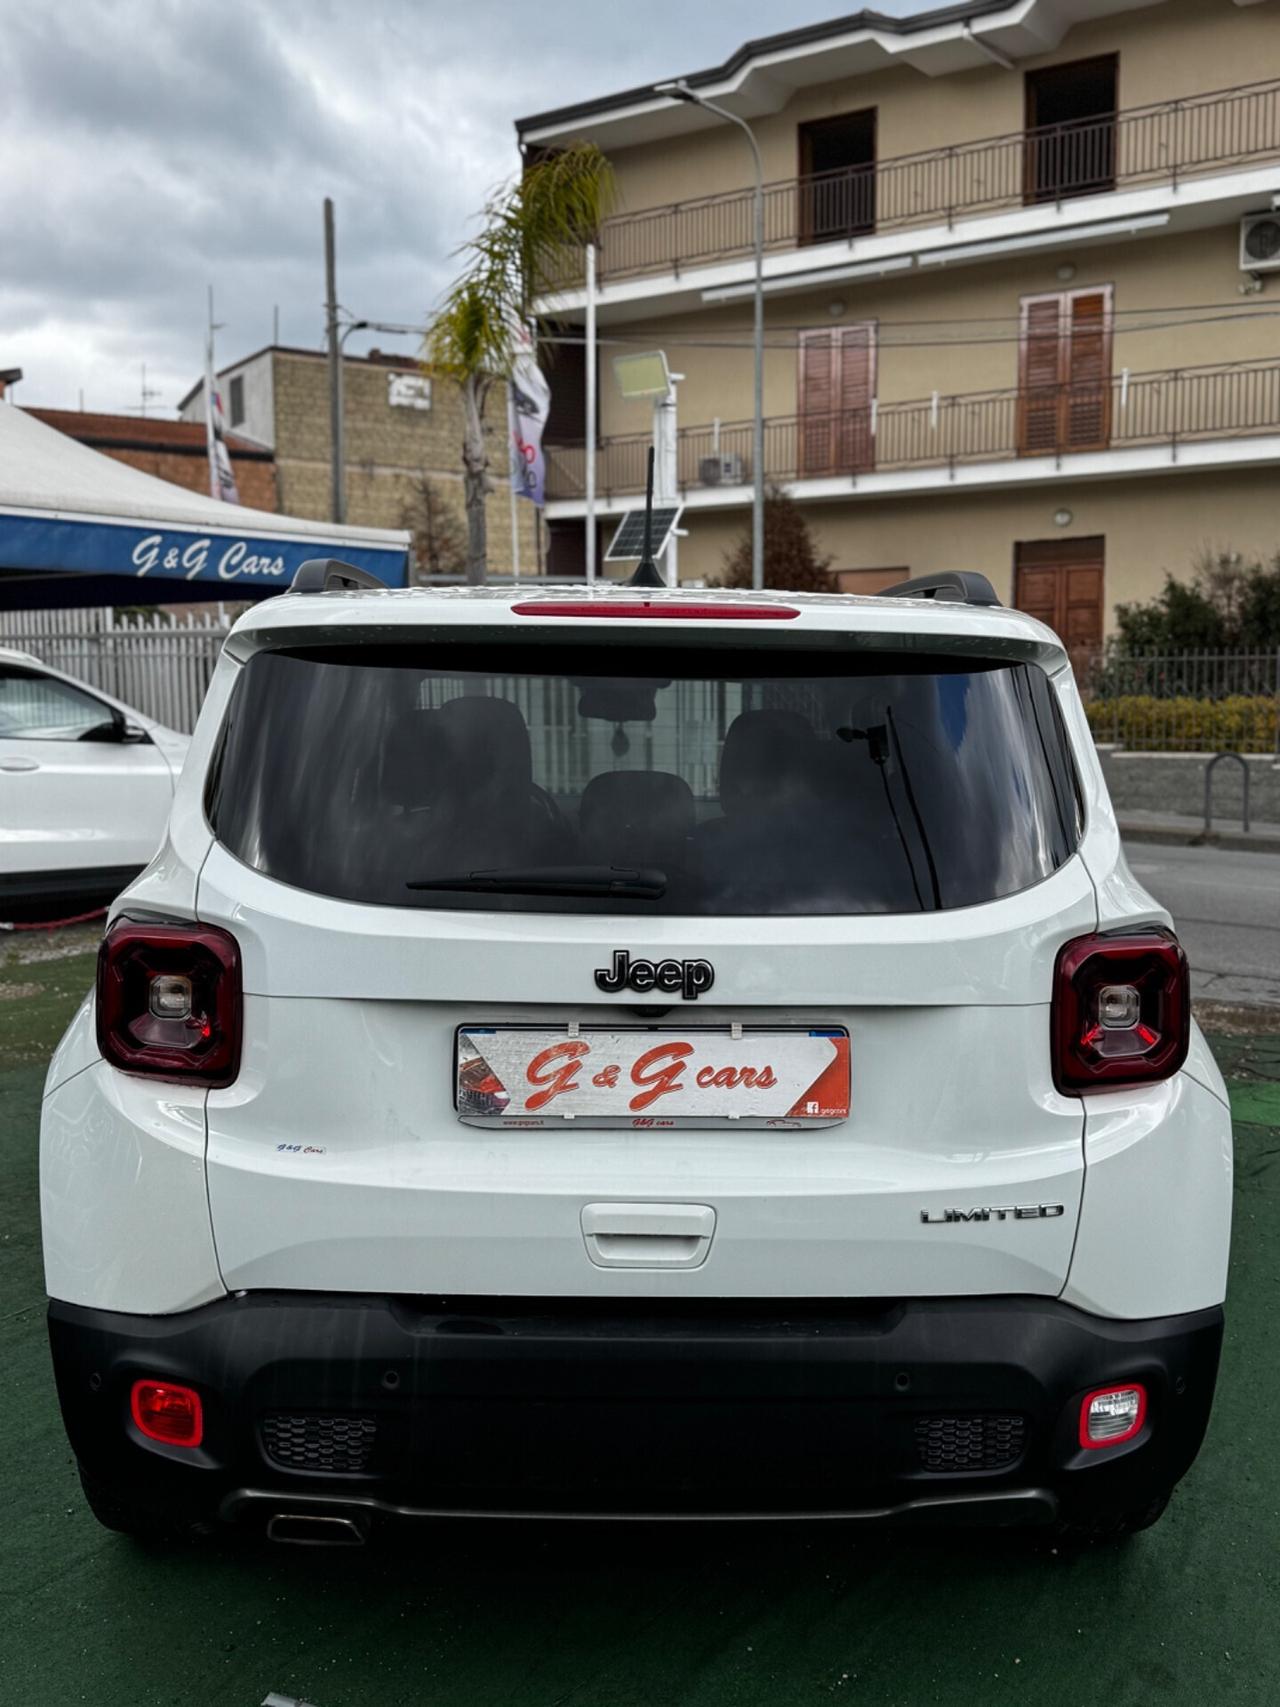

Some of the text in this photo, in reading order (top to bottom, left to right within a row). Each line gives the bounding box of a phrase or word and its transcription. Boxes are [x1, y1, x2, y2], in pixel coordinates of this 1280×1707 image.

[218, 541, 285, 579] Cars
[594, 950, 715, 1000] Jeep
[697, 1065, 778, 1090] cars
[920, 1202, 1064, 1223] LIMITED
